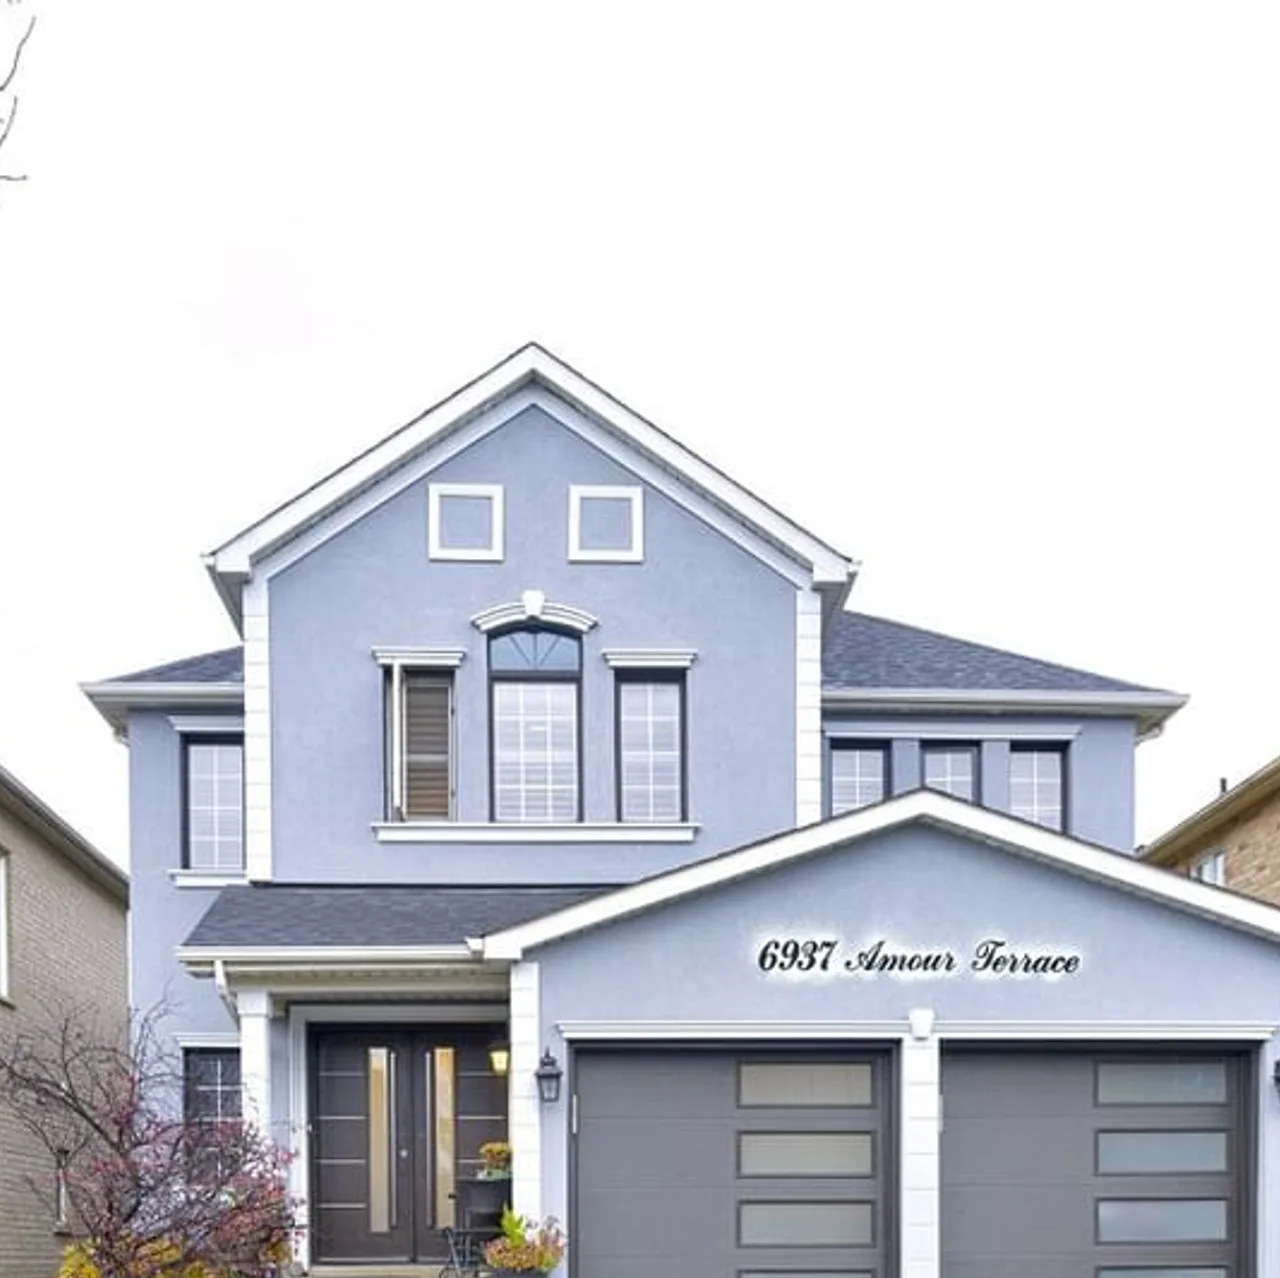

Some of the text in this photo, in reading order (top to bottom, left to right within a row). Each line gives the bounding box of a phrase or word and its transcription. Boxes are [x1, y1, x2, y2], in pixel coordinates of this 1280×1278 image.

[758, 940, 1081, 974] 6937 Amour Terrace
